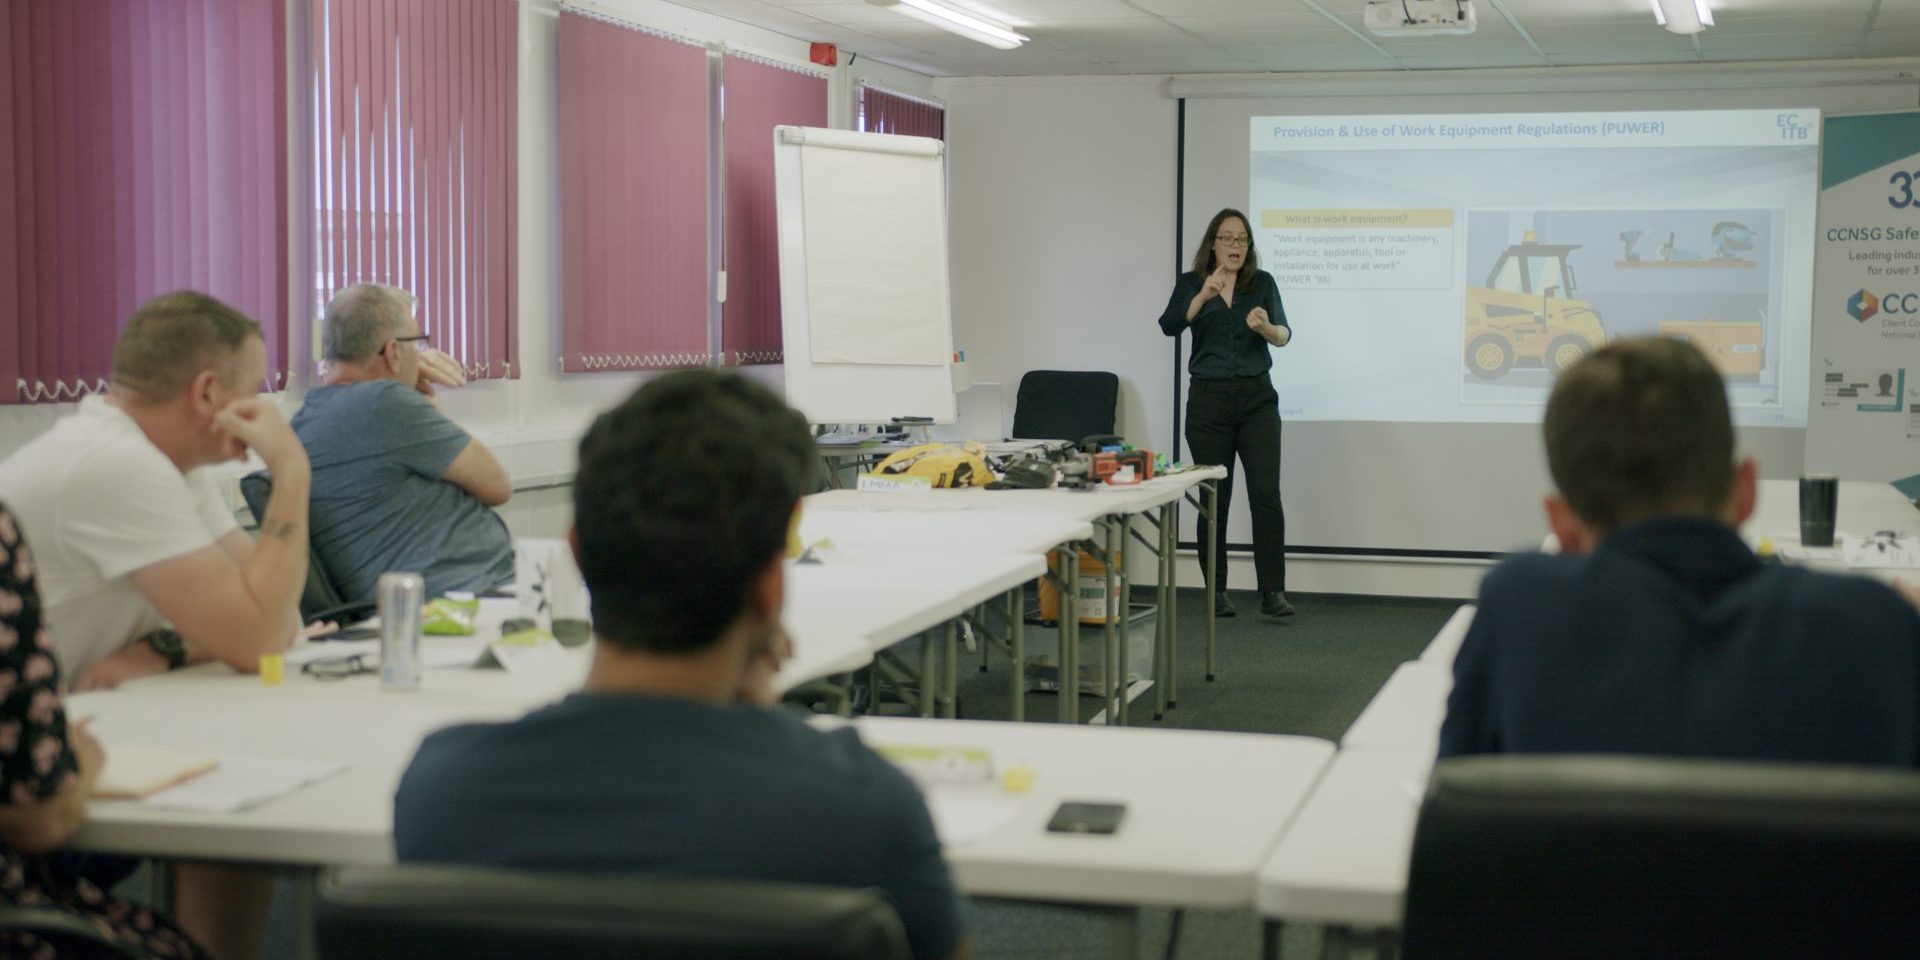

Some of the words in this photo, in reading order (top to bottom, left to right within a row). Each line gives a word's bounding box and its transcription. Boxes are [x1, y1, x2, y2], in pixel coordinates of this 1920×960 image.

[1776, 114, 1799, 127] EC
[1273, 124, 1335, 138] Provision
[1338, 124, 1349, 138] &
[1353, 124, 1378, 137] Use
[1382, 123, 1397, 137] of
[1400, 123, 1436, 137] Work
[1439, 122, 1513, 139] Equipment
[1517, 121, 1598, 138] Regulations
[1601, 120, 1665, 137] (PUWER)
[1285, 213, 1311, 224] What
[1324, 213, 1348, 224] work
[1350, 213, 1408, 226] equipment?
[1305, 233, 1356, 245] equipment
[1359, 233, 1367, 244] is
[1368, 235, 1386, 245] any
[1388, 233, 1439, 245] machinery,
[1827, 227, 1882, 242] CCNSG
[1375, 247, 1394, 257] tool
[1396, 248, 1406, 257] or
[1848, 249, 1893, 263] Leading
[1273, 261, 1326, 271] installation
[1327, 261, 1340, 271] for
[1342, 262, 1358, 271] use
[1360, 261, 1371, 271] at
[1868, 265, 1883, 276] for
[1885, 266, 1911, 276] over
[1881, 318, 1907, 328] Client
